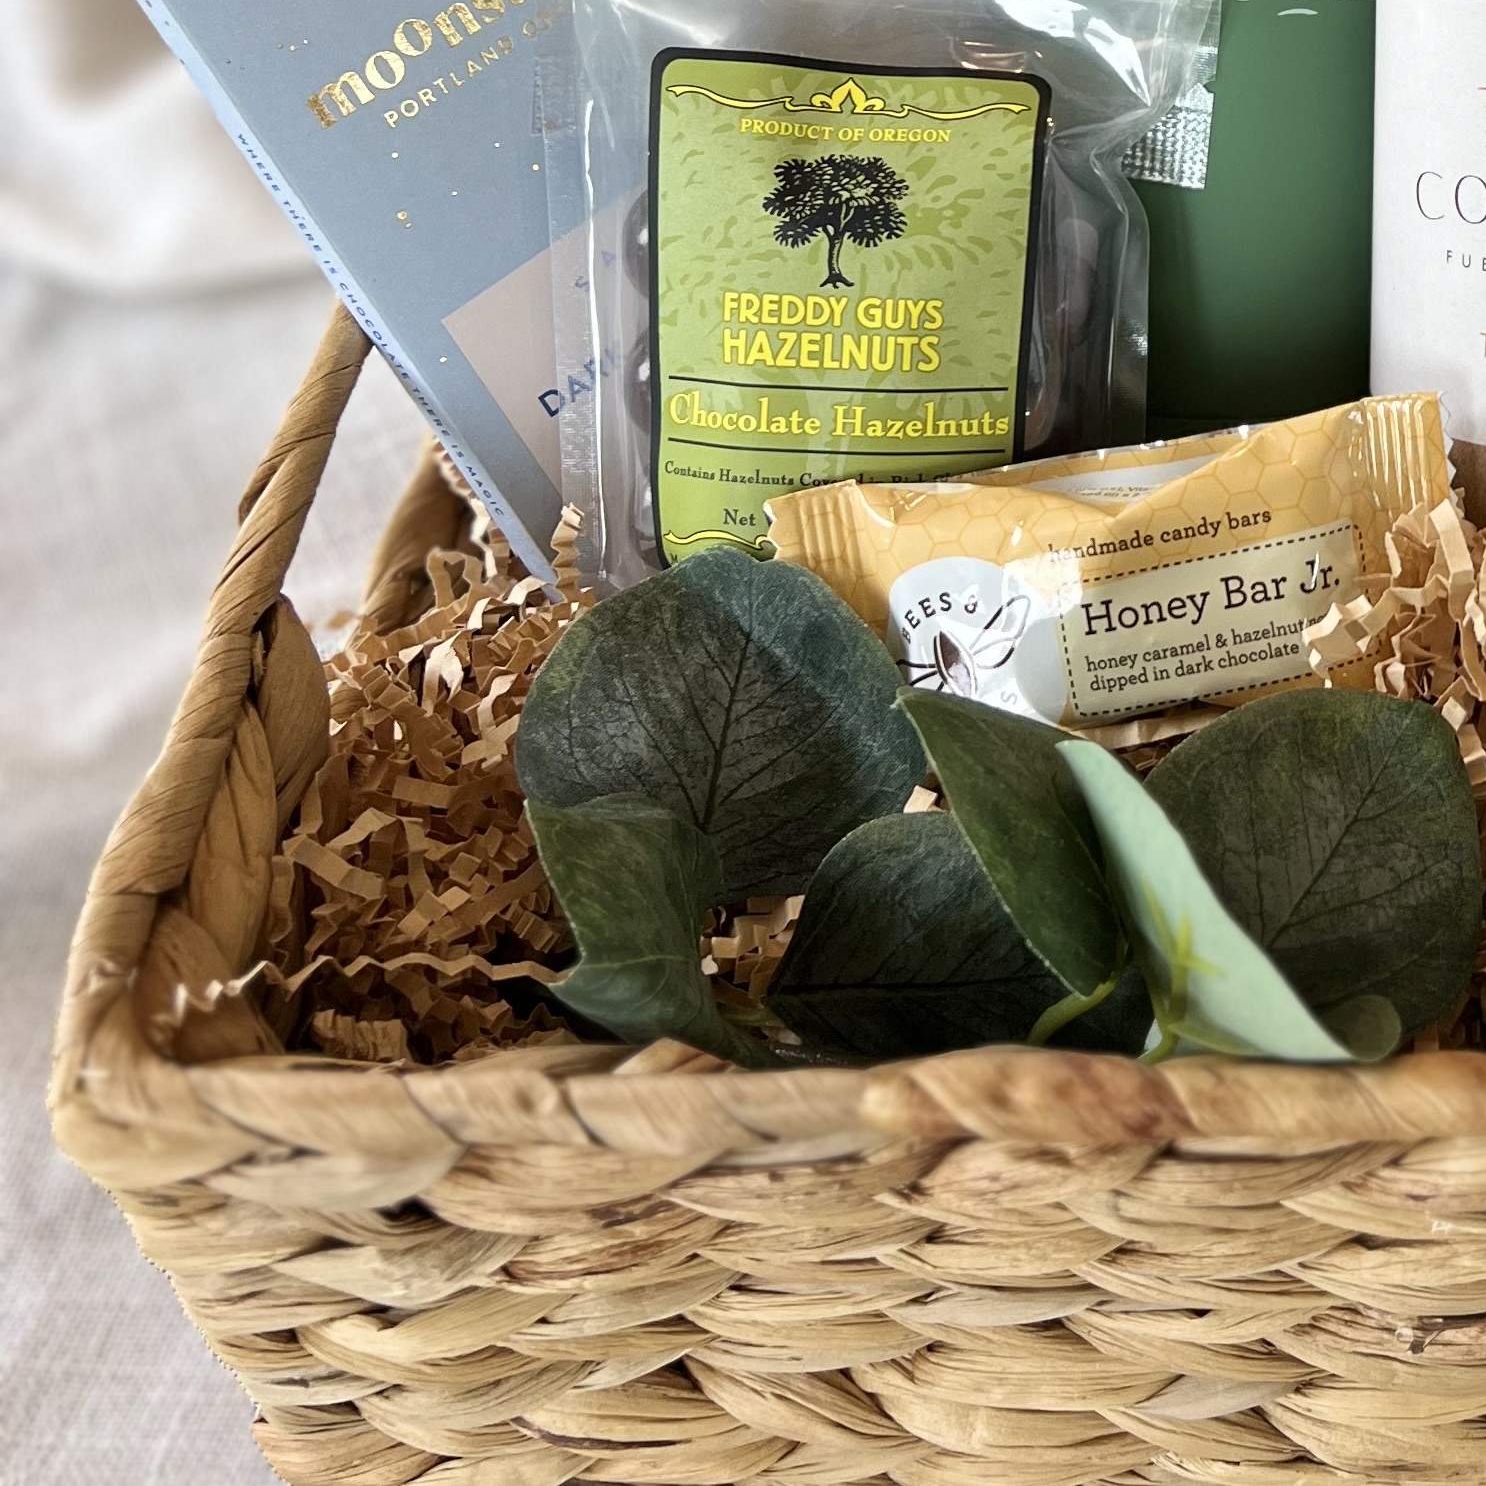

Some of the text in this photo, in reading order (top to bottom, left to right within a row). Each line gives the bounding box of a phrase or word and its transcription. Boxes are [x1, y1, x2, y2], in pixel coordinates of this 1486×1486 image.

[384, 35, 514, 128] PORTLAND
[740, 118, 951, 143] PRODUCT OF OREGON
[238, 134, 504, 516] WHERE THERE IS CHOCOLATE THERE IS MAGIC
[723, 292, 944, 330] FREDDY GUYS
[723, 329, 940, 372] HAZELNUTS
[668, 391, 1010, 440] Chocolate Hazelnuts
[665, 461, 715, 481] Contains
[719, 469, 794, 487] Hazelnuts
[723, 509, 756, 526] Net
[1048, 510, 1272, 563] handmade candy bars
[902, 592, 952, 644] BEES
[1081, 559, 1339, 636] Honey Bar Jr.
[1085, 621, 1304, 672] honey caramel & hazelnut
[1090, 642, 1300, 693] dipped in dark chocolate
